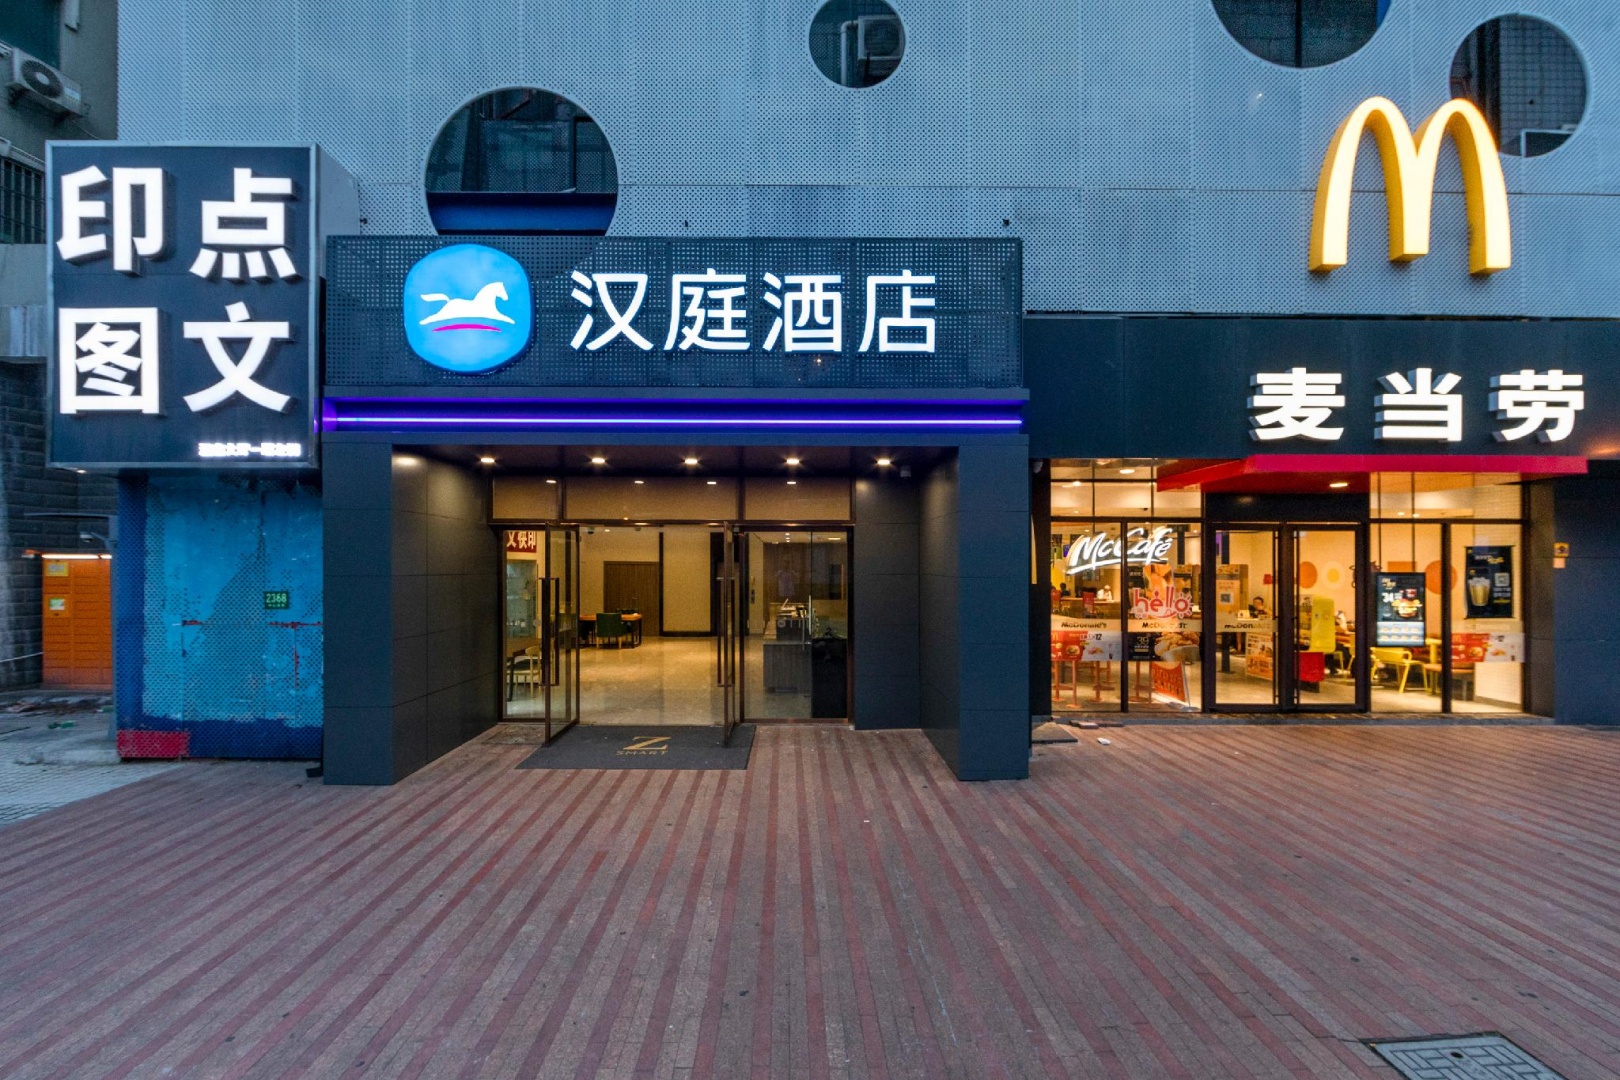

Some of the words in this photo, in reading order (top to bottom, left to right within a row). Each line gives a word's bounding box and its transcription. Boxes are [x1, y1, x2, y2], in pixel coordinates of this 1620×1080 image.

[570, 267, 937, 355] 汉庭酒店
[1250, 367, 1585, 443] 麦当劳
[266, 593, 287, 603] 2368
[1134, 586, 1189, 613] hello
